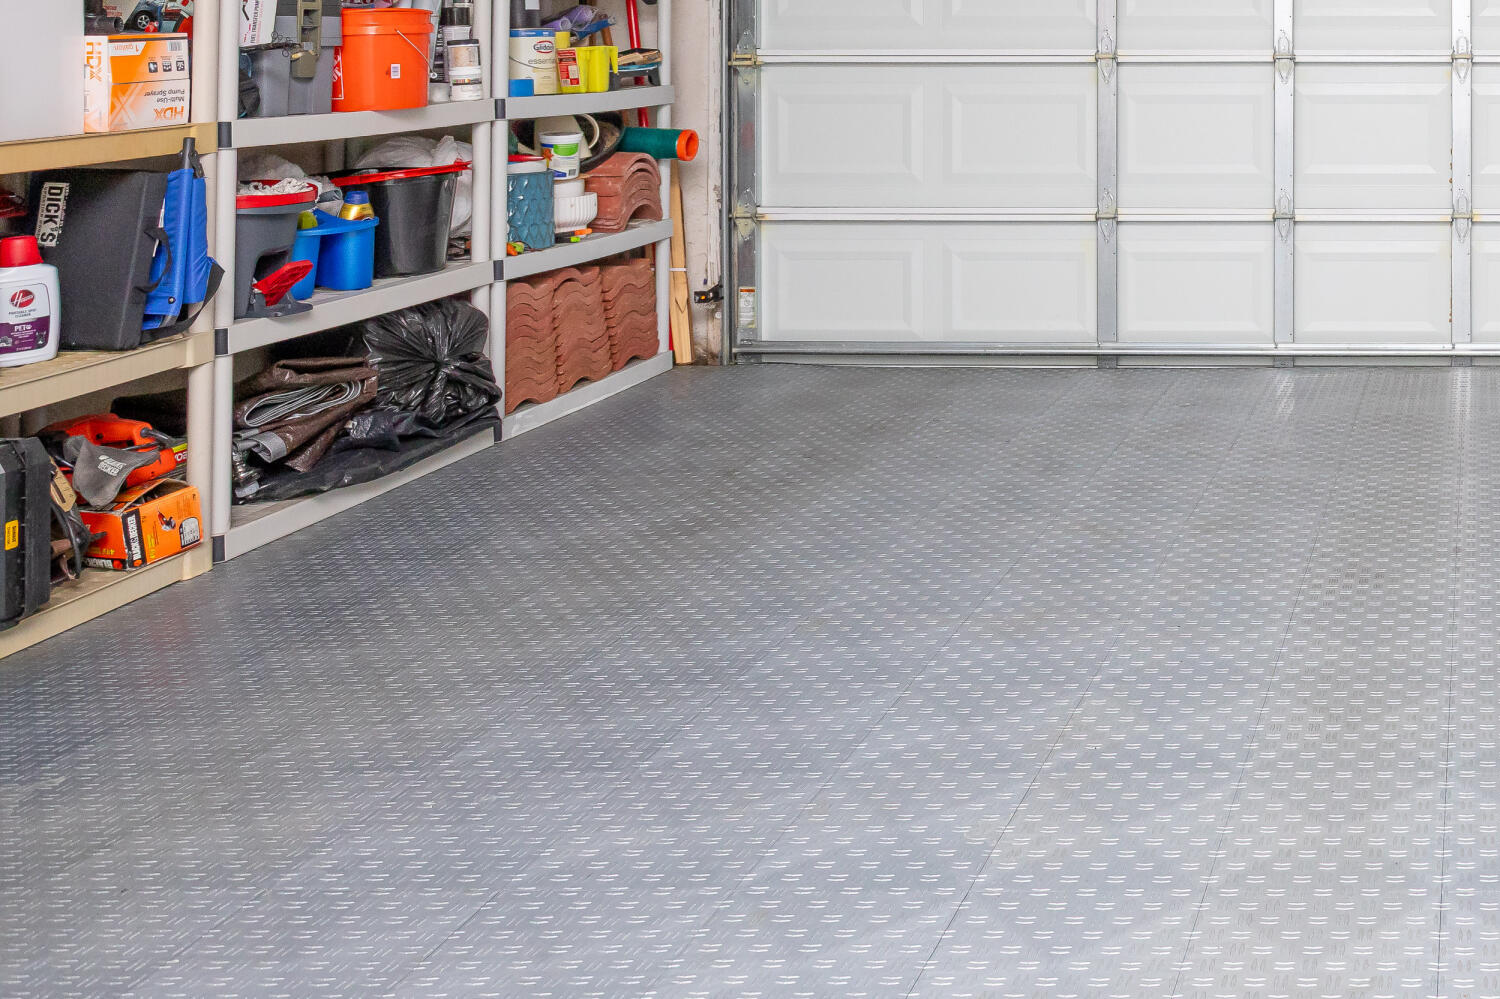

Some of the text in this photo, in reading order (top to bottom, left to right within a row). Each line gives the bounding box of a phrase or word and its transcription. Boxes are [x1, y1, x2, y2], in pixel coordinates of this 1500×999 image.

[86, 41, 102, 82] HDX
[144, 88, 185, 97] Pump Sprayer
[156, 95, 184, 104] Multi-Use
[154, 105, 184, 121] HDX
[41, 186, 64, 243] DICK'S
